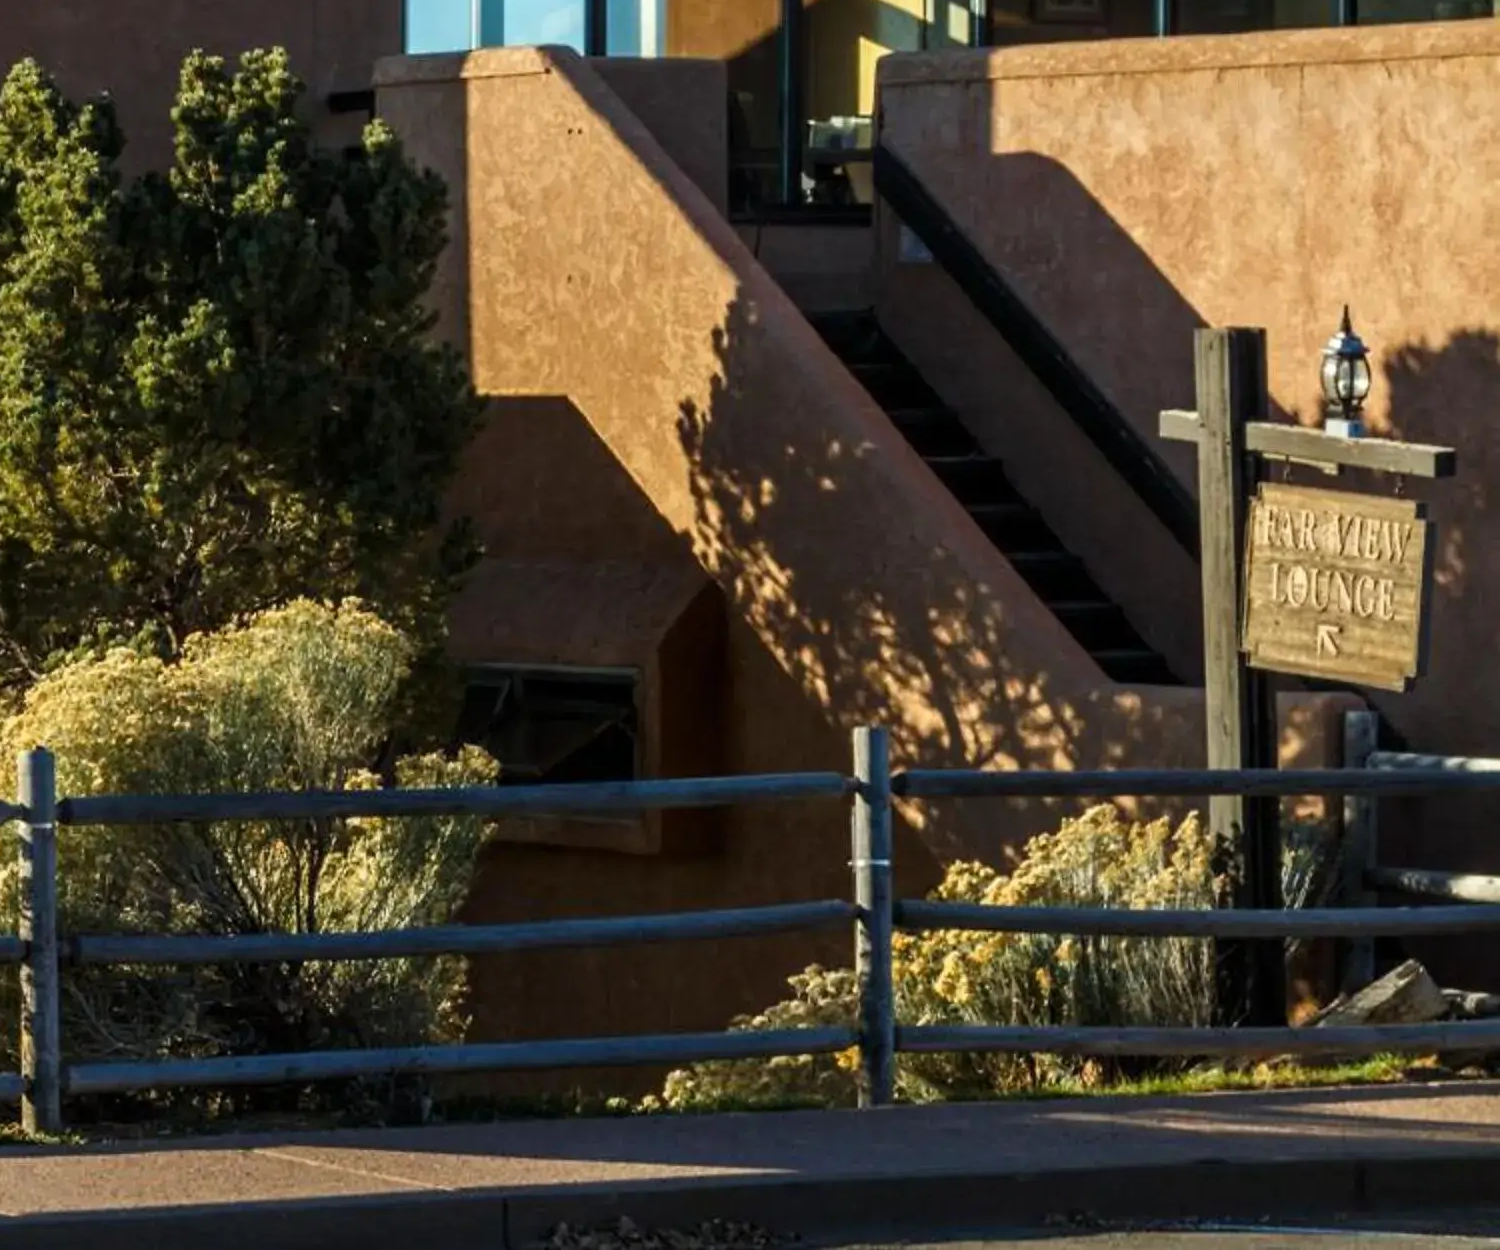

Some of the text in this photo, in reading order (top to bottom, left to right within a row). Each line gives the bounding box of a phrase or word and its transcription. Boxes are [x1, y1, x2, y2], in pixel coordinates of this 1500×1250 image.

[1262, 505, 1412, 563] FAR VIEW
[1271, 563, 1396, 620] LOUNGE
